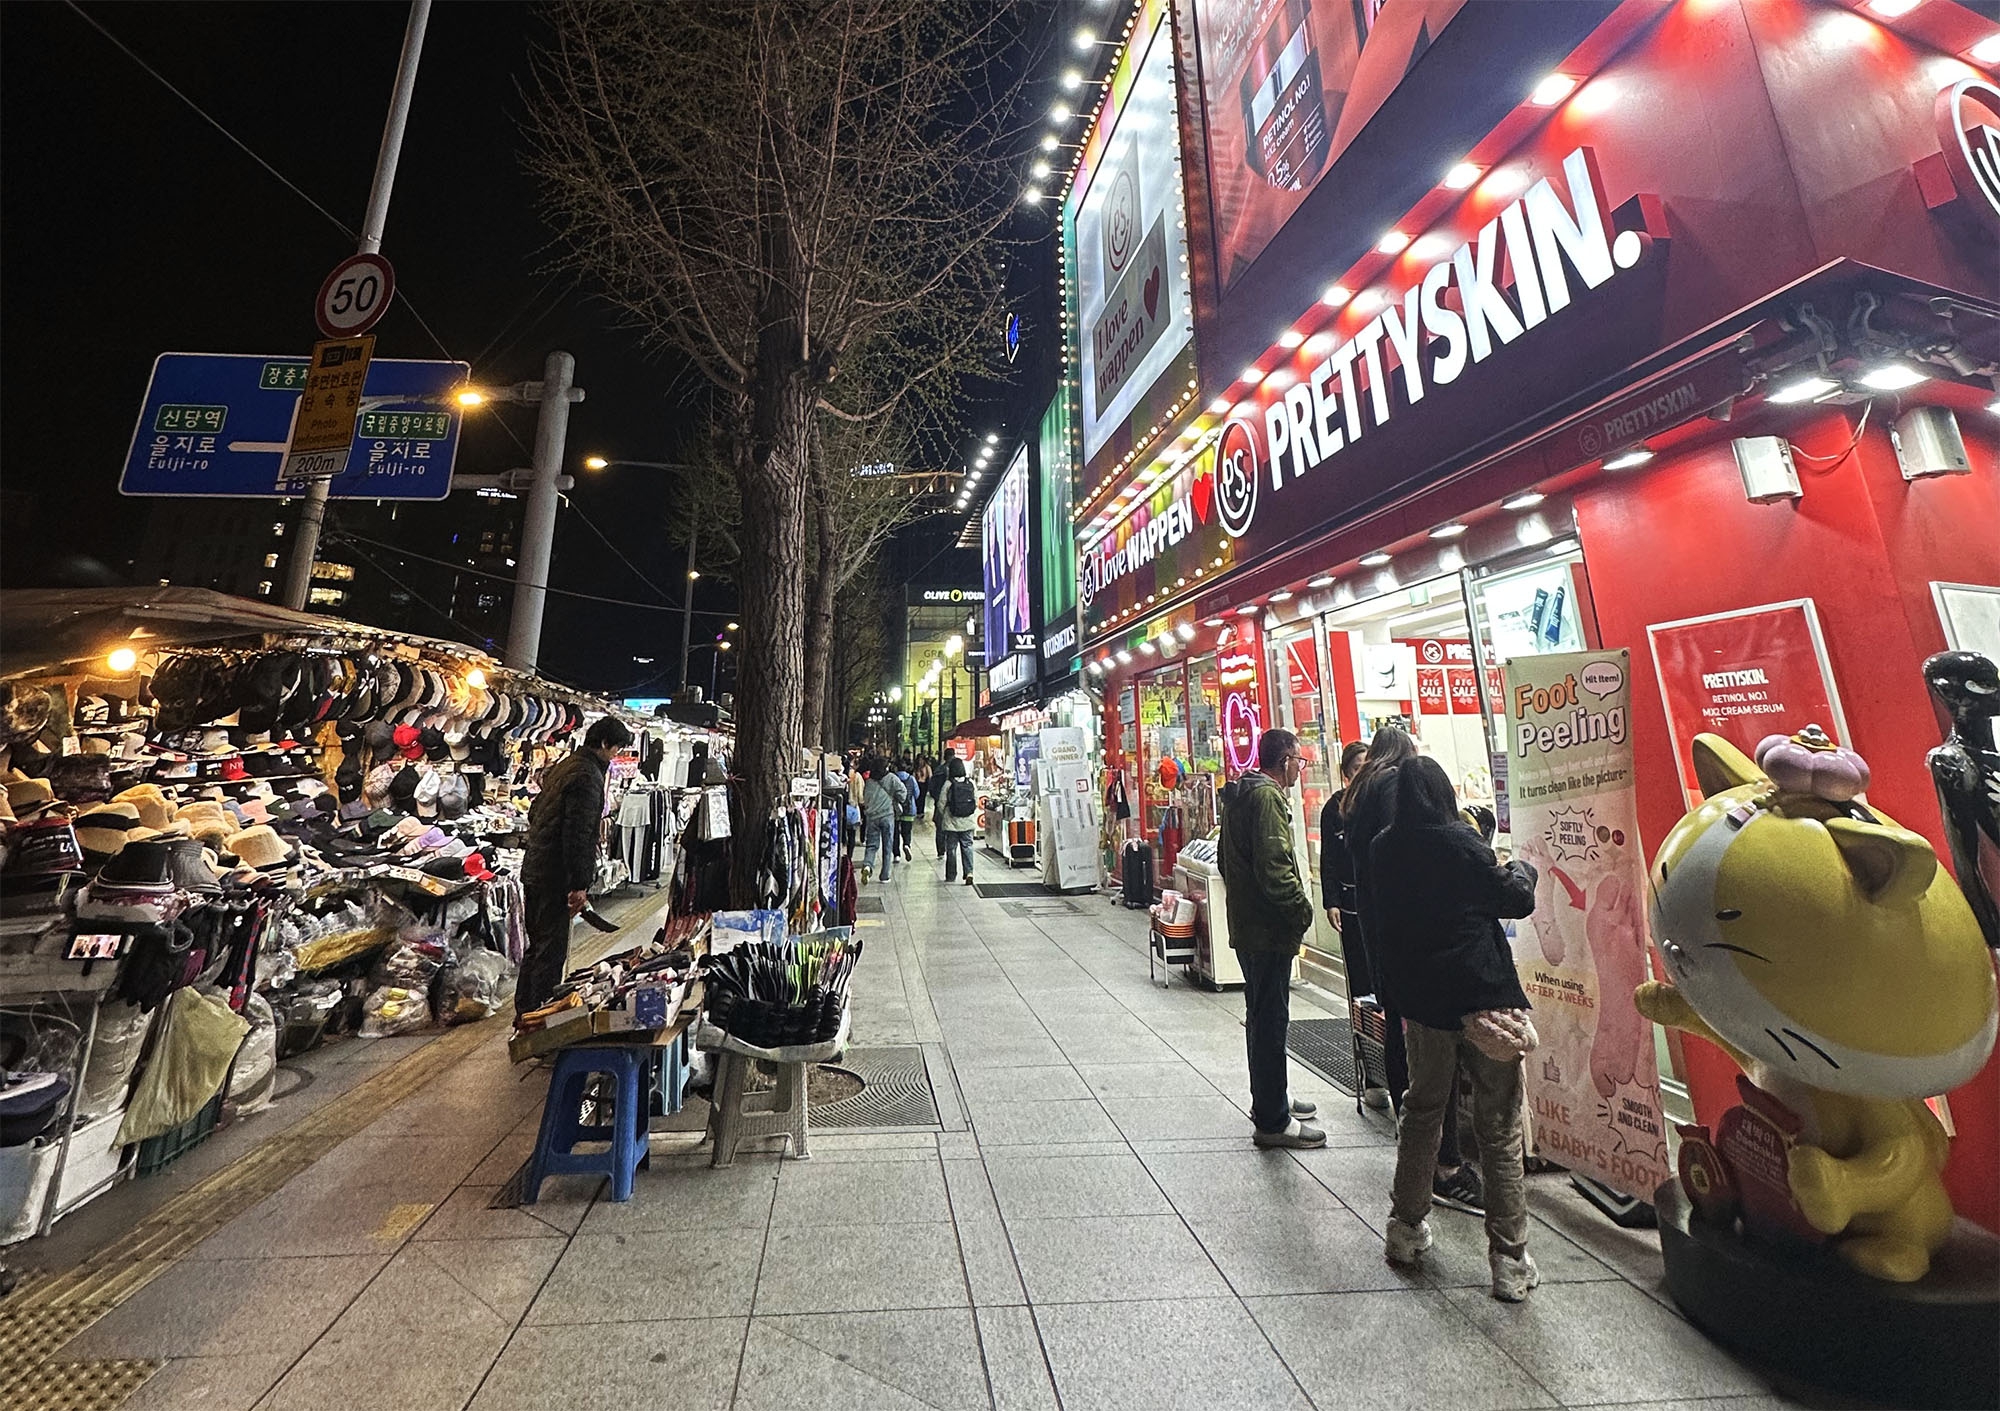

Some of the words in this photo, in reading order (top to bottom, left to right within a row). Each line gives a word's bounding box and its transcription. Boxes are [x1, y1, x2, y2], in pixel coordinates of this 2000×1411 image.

[1263, 98, 1296, 150] RETINOL
[1295, 74, 1311, 107] NO.1
[1276, 118, 1296, 148] cream
[330, 275, 378, 316] 50
[1098, 330, 1104, 361] I
[1105, 298, 1129, 346] love
[1099, 315, 1146, 396] wappen
[163, 409, 223, 430] 신당역
[366, 415, 446, 435] 국립중앙의료원
[150, 435, 217, 457] 을지로
[369, 441, 432, 463] 을지로
[148, 457, 209, 472] Eulji-ro
[296, 455, 336, 474] 200m
[368, 461, 426, 478] Eulji-ro
[1126, 492, 1194, 574] WAPPEN
[923, 590, 951, 600] OLIVE
[1015, 634, 1036, 645] VT
[1422, 678, 1440, 686] BIG
[1454, 678, 1473, 686] BIG
[1585, 674, 1598, 684] Hit
[1598, 673, 1620, 684] Item!
[1420, 685, 1444, 697] SALE
[1452, 685, 1477, 697] SALE
[1514, 673, 1579, 720] Foot
[1712, 693, 1748, 704] RETINOL
[1747, 690, 1768, 701] NO.1
[1702, 706, 1722, 718] MX2
[1516, 706, 1626, 757] Peeling
[1052, 746, 1077, 754] GRAND
[1053, 753, 1080, 761] WINNER
[1519, 785, 1527, 799] It
[1526, 782, 1548, 798] turns
[1547, 777, 1567, 794] clean
[1567, 774, 1582, 791] like
[1582, 772, 1596, 788] the
[1559, 820, 1584, 834] SOFTLY
[1559, 834, 1587, 846] PEELING
[1535, 971, 1562, 987] When
[1561, 979, 1585, 996] using
[1525, 983, 1556, 1000] AFTER
[1557, 988, 1564, 1001] 2
[1562, 991, 1595, 1009] WEEKS
[1536, 1095, 1571, 1126] LIKE
[1621, 1097, 1654, 1119] SMOOTH
[1617, 1111, 1633, 1127] AND
[1537, 1125, 1548, 1144] A
[1550, 1129, 1608, 1170] BABY'S
